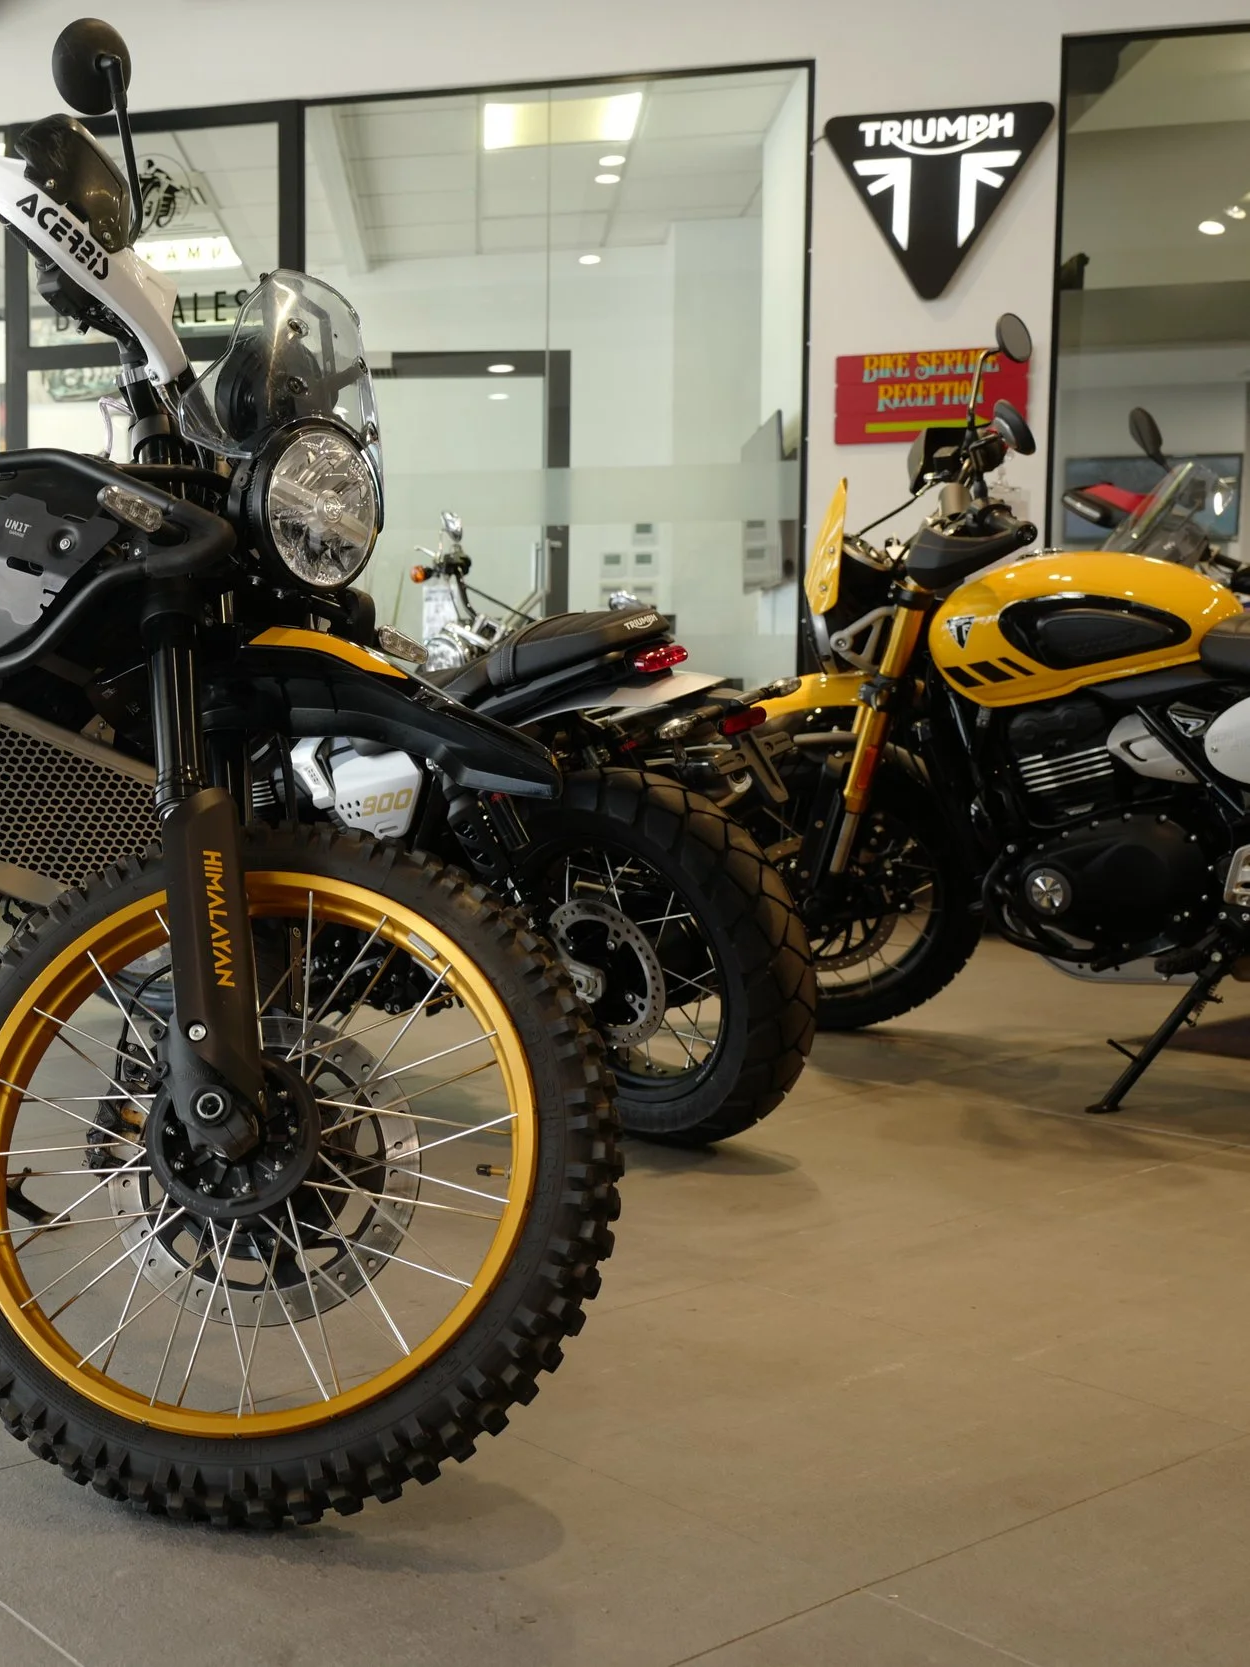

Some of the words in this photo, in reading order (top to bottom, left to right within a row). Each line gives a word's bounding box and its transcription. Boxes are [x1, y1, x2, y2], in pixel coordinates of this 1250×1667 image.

[858, 111, 1015, 155] TRIUMPH
[15, 193, 109, 280] ACERBIS
[861, 352, 910, 383] BIKE
[876, 379, 984, 412] RECEPTION
[623, 613, 659, 630] TRIUMPH
[361, 788, 414, 817] 900
[202, 850, 236, 988] HIMALAYAN
